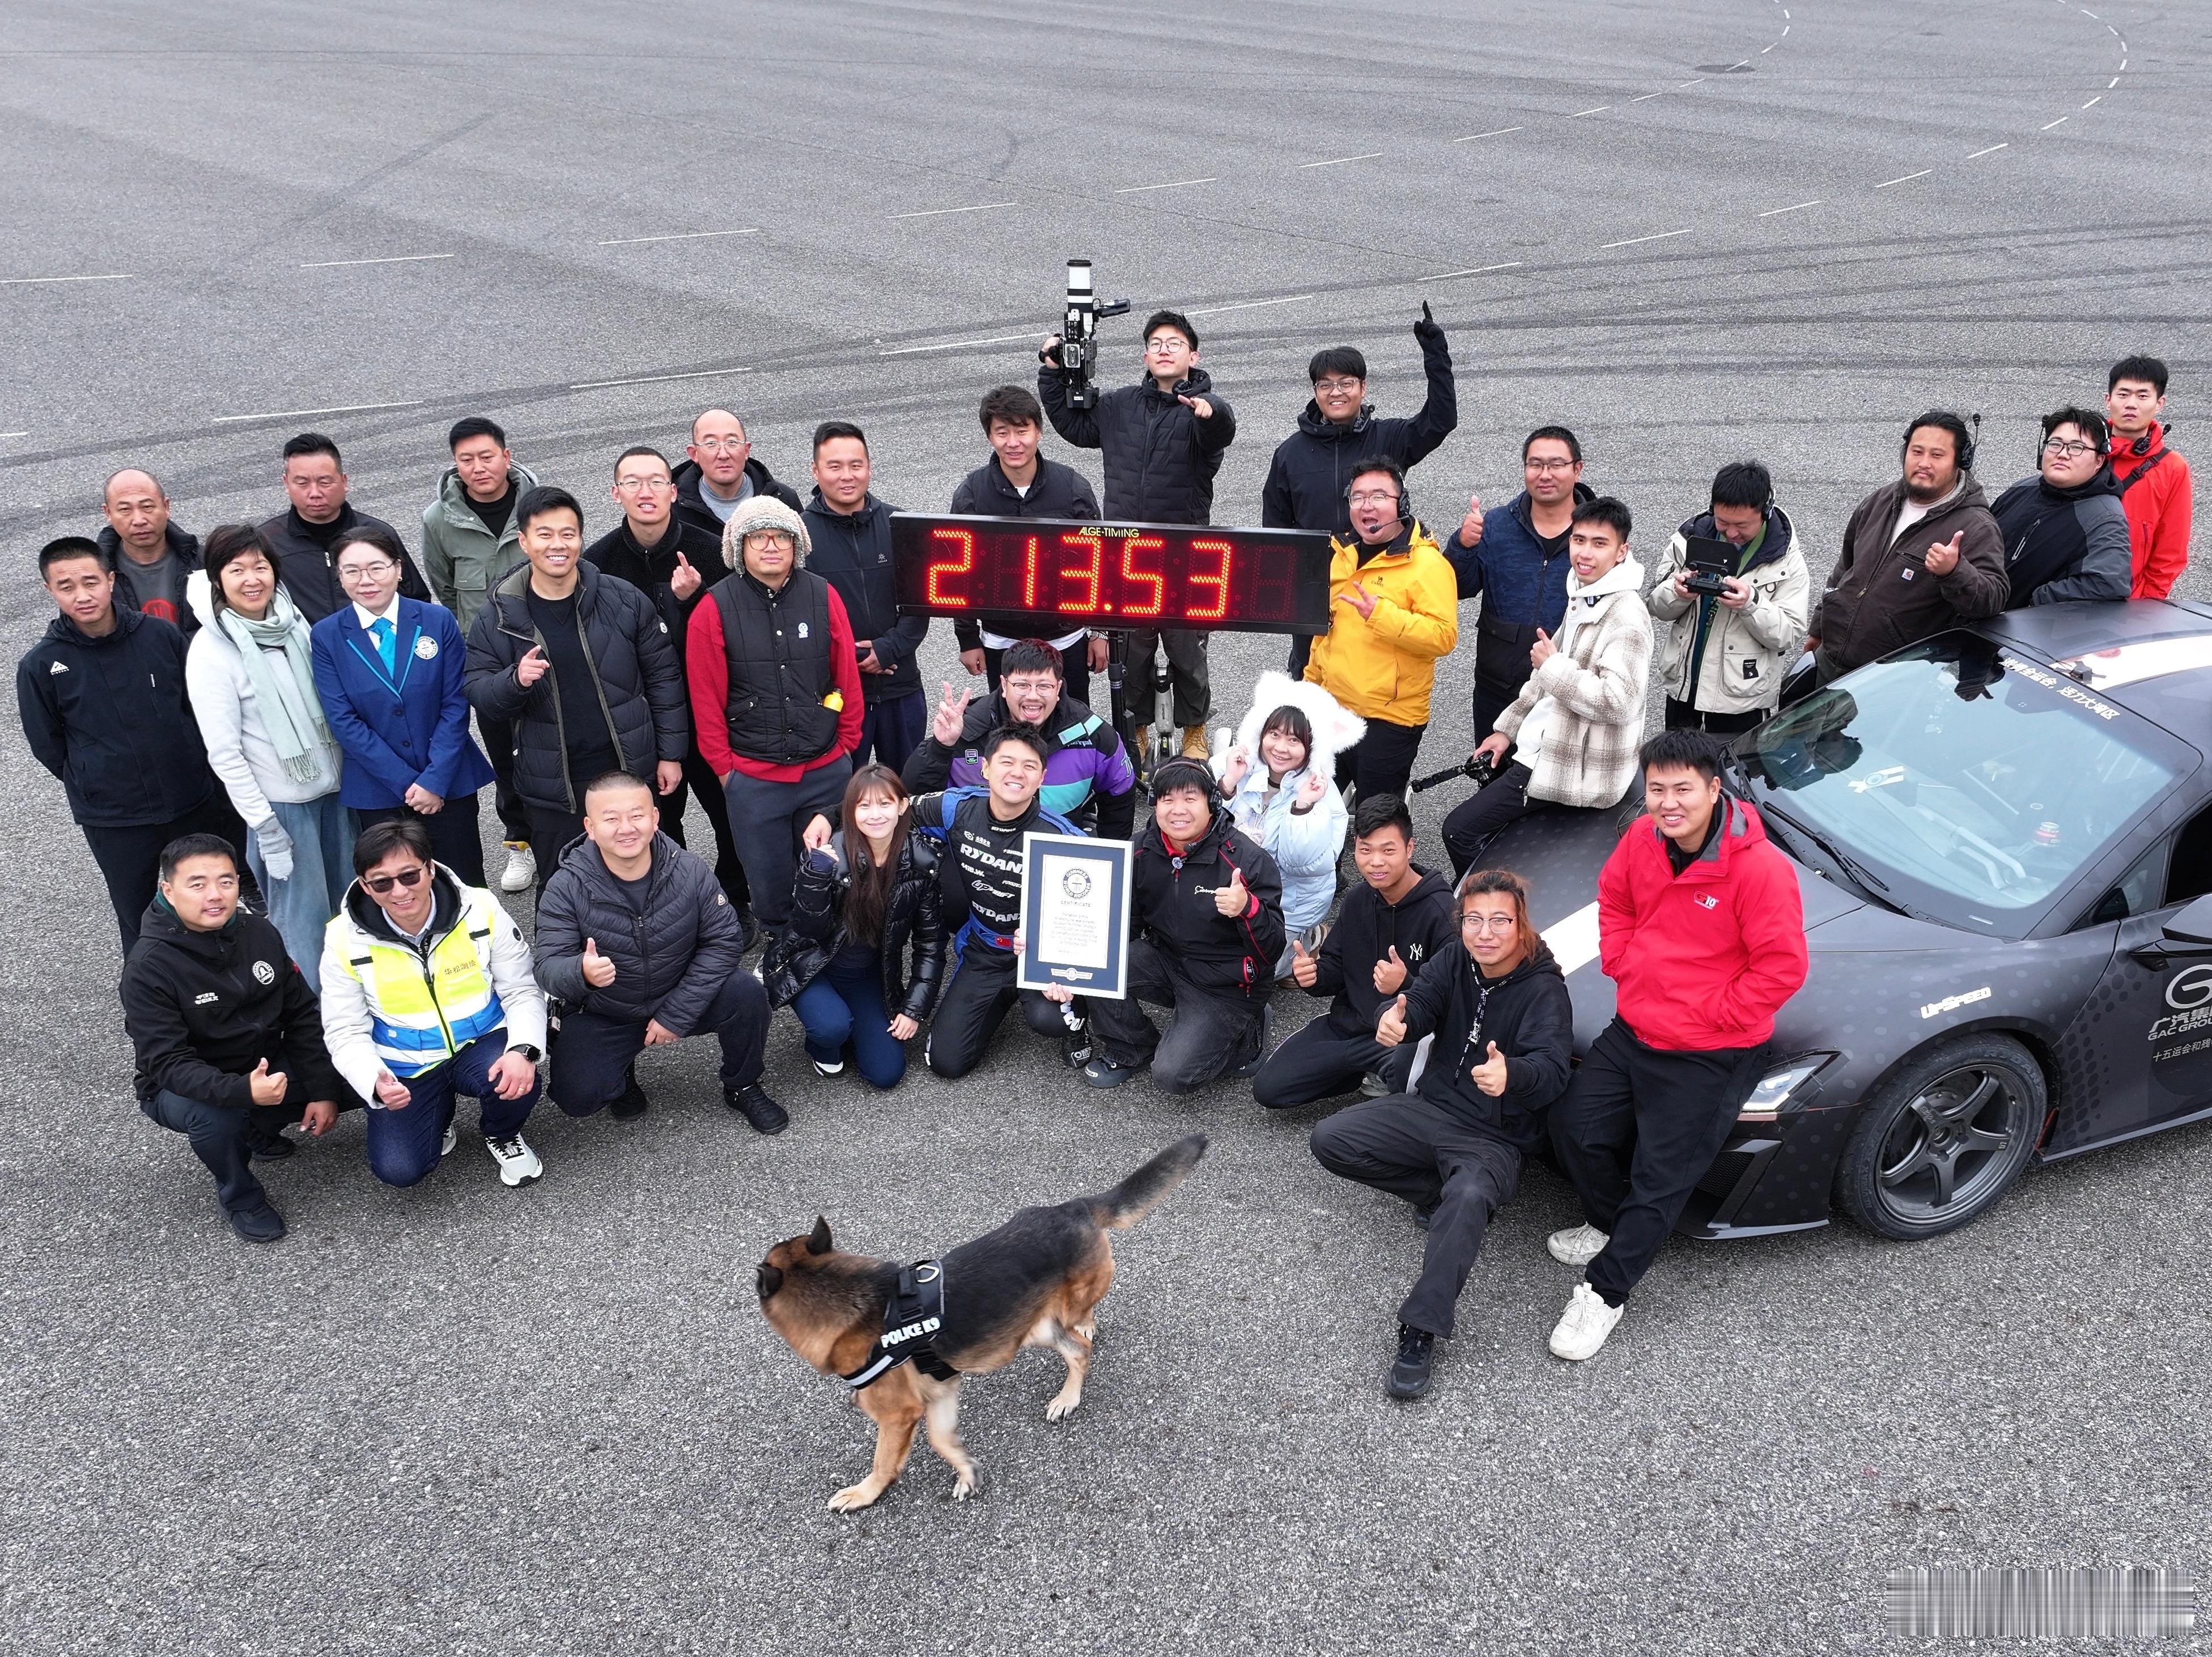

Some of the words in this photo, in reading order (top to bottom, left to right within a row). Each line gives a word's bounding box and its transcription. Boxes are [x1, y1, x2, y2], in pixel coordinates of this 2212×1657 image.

[1079, 526, 1140, 538] ALGE-TIMING
[928, 529, 1232, 618] 213.53
[960, 843, 1023, 876] RYDAN
[2147, 1027, 2177, 1041] GAC
[2149, 1005, 2212, 1034] 广汽集
[2152, 1038, 2212, 1063] 十五运会和残
[880, 1323, 924, 1348] POLICE
[922, 1317, 941, 1333] K9
